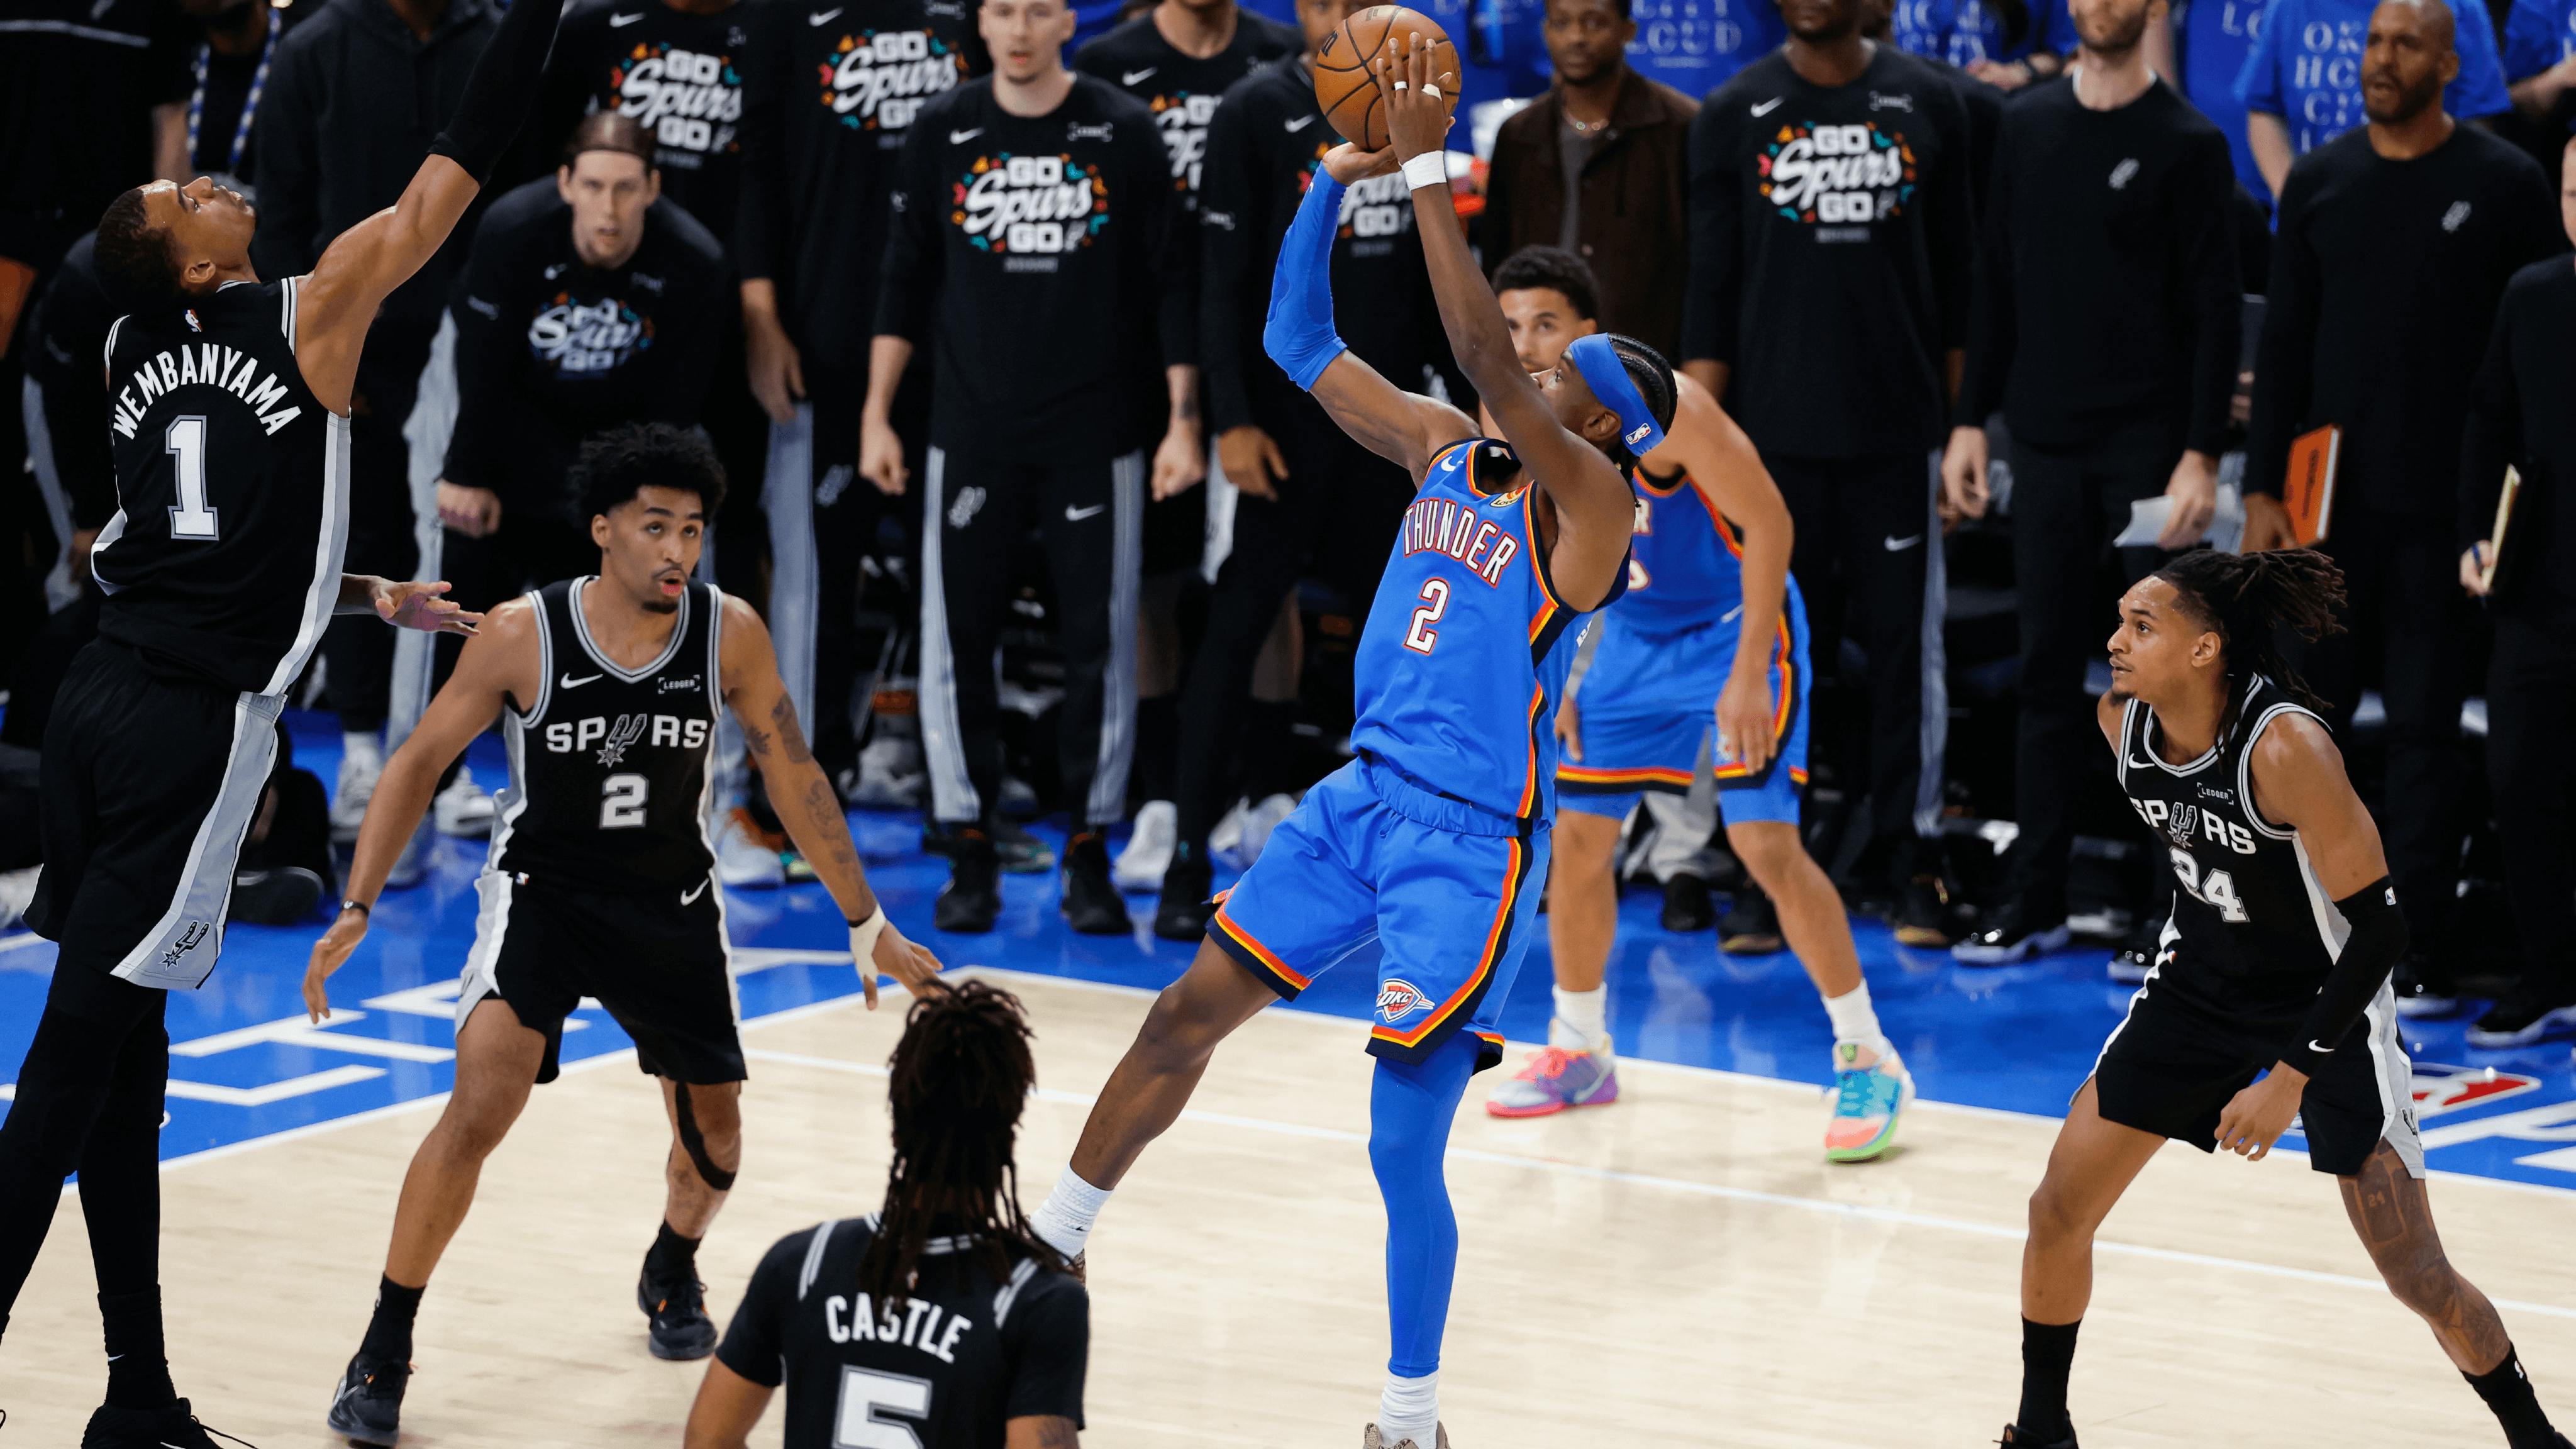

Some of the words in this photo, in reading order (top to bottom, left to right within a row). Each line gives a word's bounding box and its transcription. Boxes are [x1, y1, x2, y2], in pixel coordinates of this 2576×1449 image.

[665, 49, 721, 86] GO
[872, 30, 928, 62] GO
[618, 57, 742, 128] Spurs
[832, 46, 958, 118] Spurs
[657, 115, 711, 151] GO
[1812, 125, 1870, 155] GO
[1008, 156, 1063, 187] GO
[1770, 138, 1902, 209] Spurs
[963, 169, 1092, 240] Spurs
[1353, 206, 1400, 237] GO
[1817, 191, 1874, 223] GO
[1008, 222, 1063, 253] GO
[113, 343, 302, 440] WEMBANYAMA
[165, 414, 219, 541] 1
[1404, 499, 1519, 589] THUNDER
[1402, 577, 1450, 656] 2
[663, 679, 695, 690] LEDGER
[546, 714, 708, 767] SPURS
[599, 772, 650, 830] 2
[2201, 787, 2229, 800] LEDGER
[2169, 845, 2250, 923] 24
[1377, 991, 1413, 1007] OKC
[825, 1292, 972, 1363] CASTLE
[831, 1363, 933, 1449] 5
